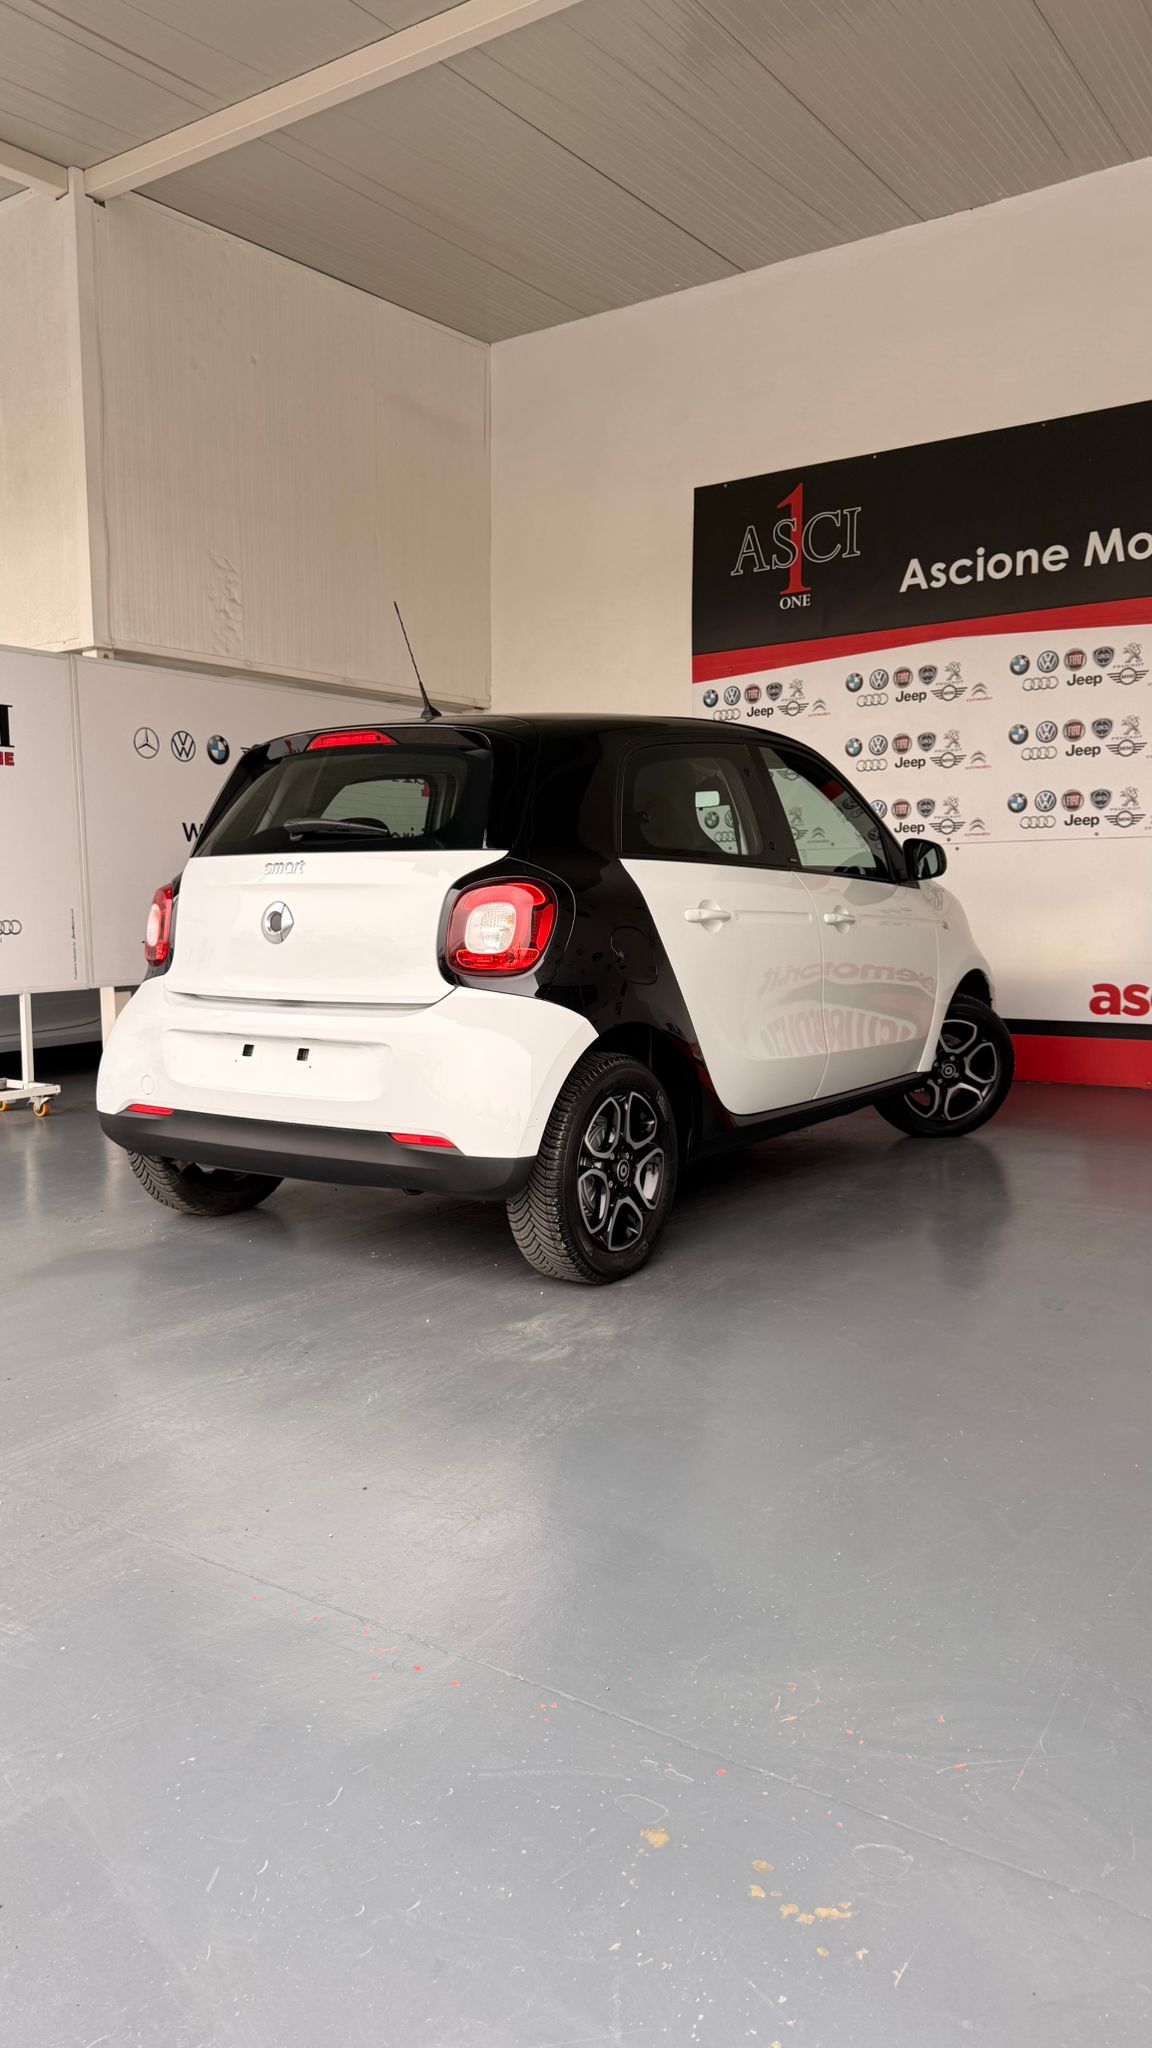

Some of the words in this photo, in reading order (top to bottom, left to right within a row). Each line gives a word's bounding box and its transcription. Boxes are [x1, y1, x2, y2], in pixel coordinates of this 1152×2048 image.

[730, 506, 862, 576] ASCI
[899, 544, 1070, 593] Ascione
[1083, 527, 1152, 567] Mo
[779, 593, 811, 610] ONE
[1066, 674, 1103, 686] Jeep
[895, 691, 927, 703] Jeep
[746, 706, 774, 718] Jeep
[1065, 744, 1101, 757] Jeep
[894, 757, 926, 769] Jeep
[1064, 814, 1100, 827] Jeep
[894, 822, 925, 834] Jeep
[263, 859, 306, 875] smart
